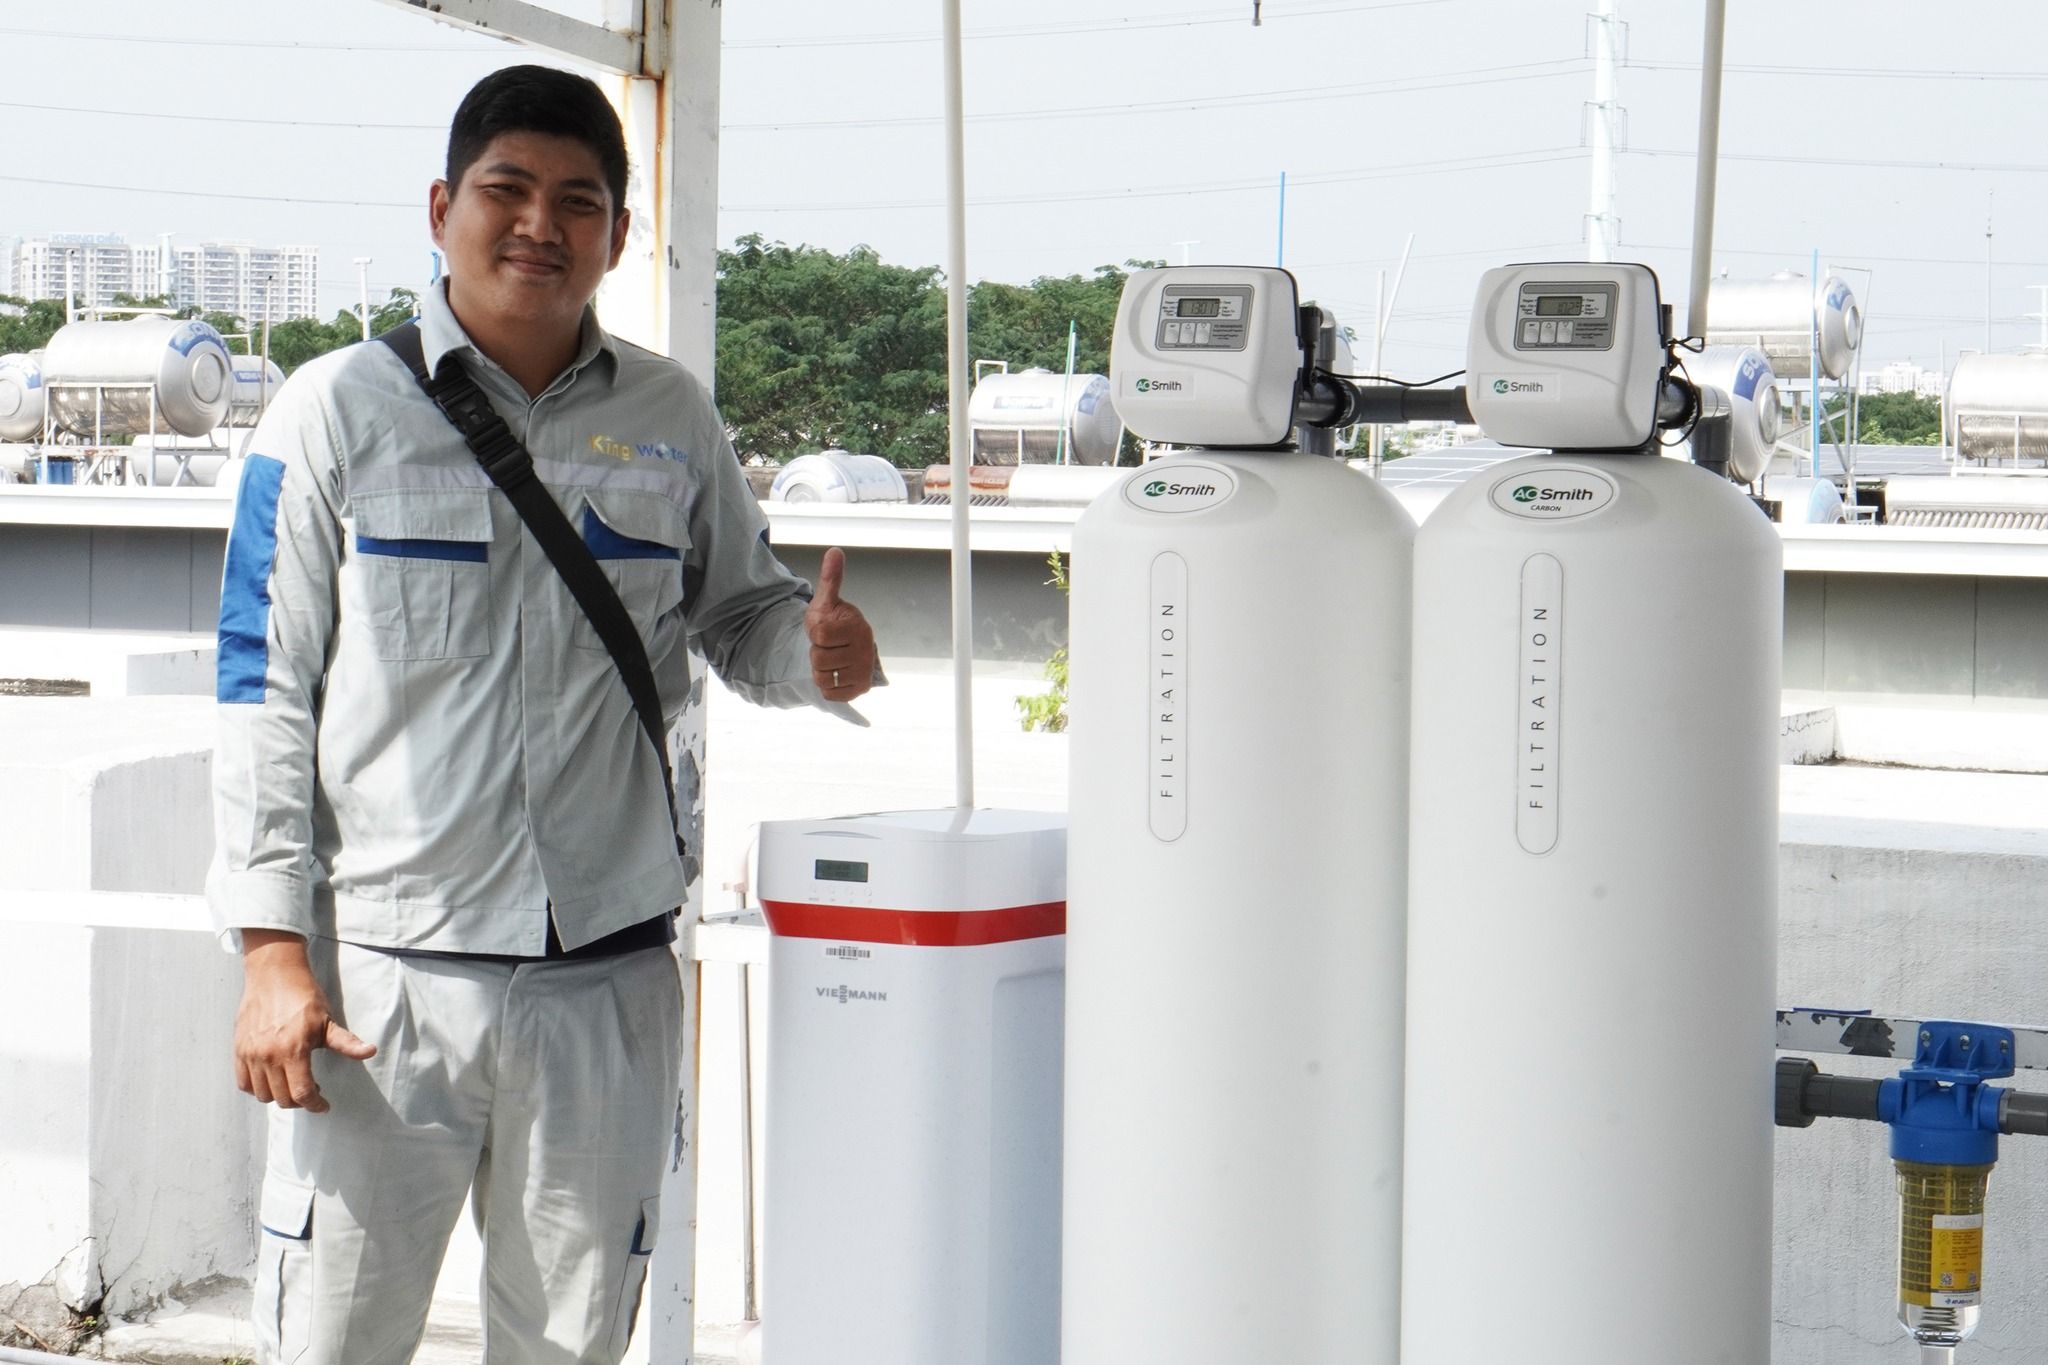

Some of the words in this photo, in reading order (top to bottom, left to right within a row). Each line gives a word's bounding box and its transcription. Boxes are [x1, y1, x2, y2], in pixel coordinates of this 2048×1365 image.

[588, 434, 631, 461] King
[1168, 483, 1216, 496] Smith
[1539, 487, 1593, 501] Smith
[1530, 504, 1561, 512] CARBON
[1161, 604, 1174, 798] FILTRATION
[1530, 608, 1547, 809] FILTRATION
[816, 984, 887, 1004] VIESSMANN
